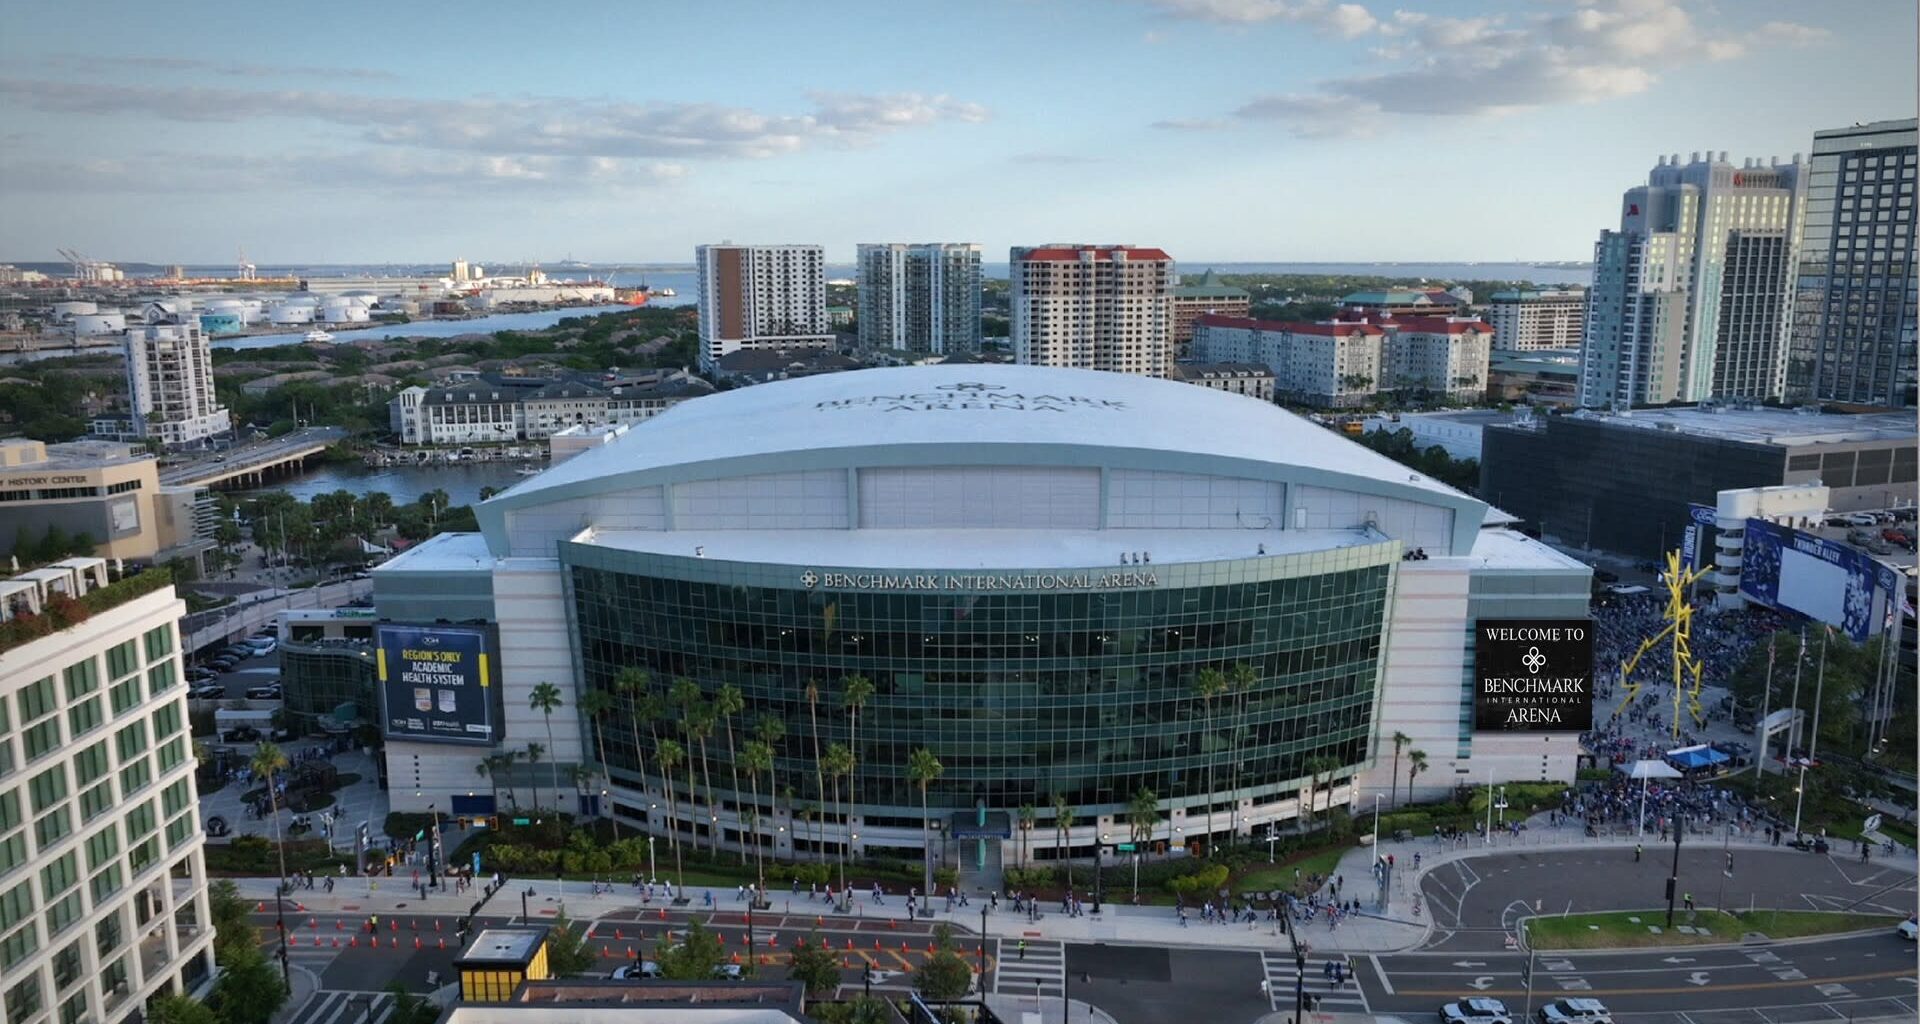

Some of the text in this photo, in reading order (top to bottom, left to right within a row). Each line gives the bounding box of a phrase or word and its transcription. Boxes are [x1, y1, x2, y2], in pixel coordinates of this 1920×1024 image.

[814, 392, 1130, 411] BENCHMARK
[884, 402, 1065, 412] ARENA
[8, 476, 48, 486] HISTORY
[51, 475, 87, 484] CENTER
[1793, 537, 1841, 563] THUNDER ALLEY
[824, 573, 1160, 590] BENCHMARK INTERNATIONAL ARENA
[1486, 628, 1584, 641] WELCOME TO
[402, 649, 461, 663] REGION'S ONLY
[412, 662, 453, 673] ACADEMIC
[402, 672, 465, 686] HEALTH SYSTEM
[1484, 678, 1584, 693] BENCHMARK
[1506, 708, 1562, 723] ARENA
